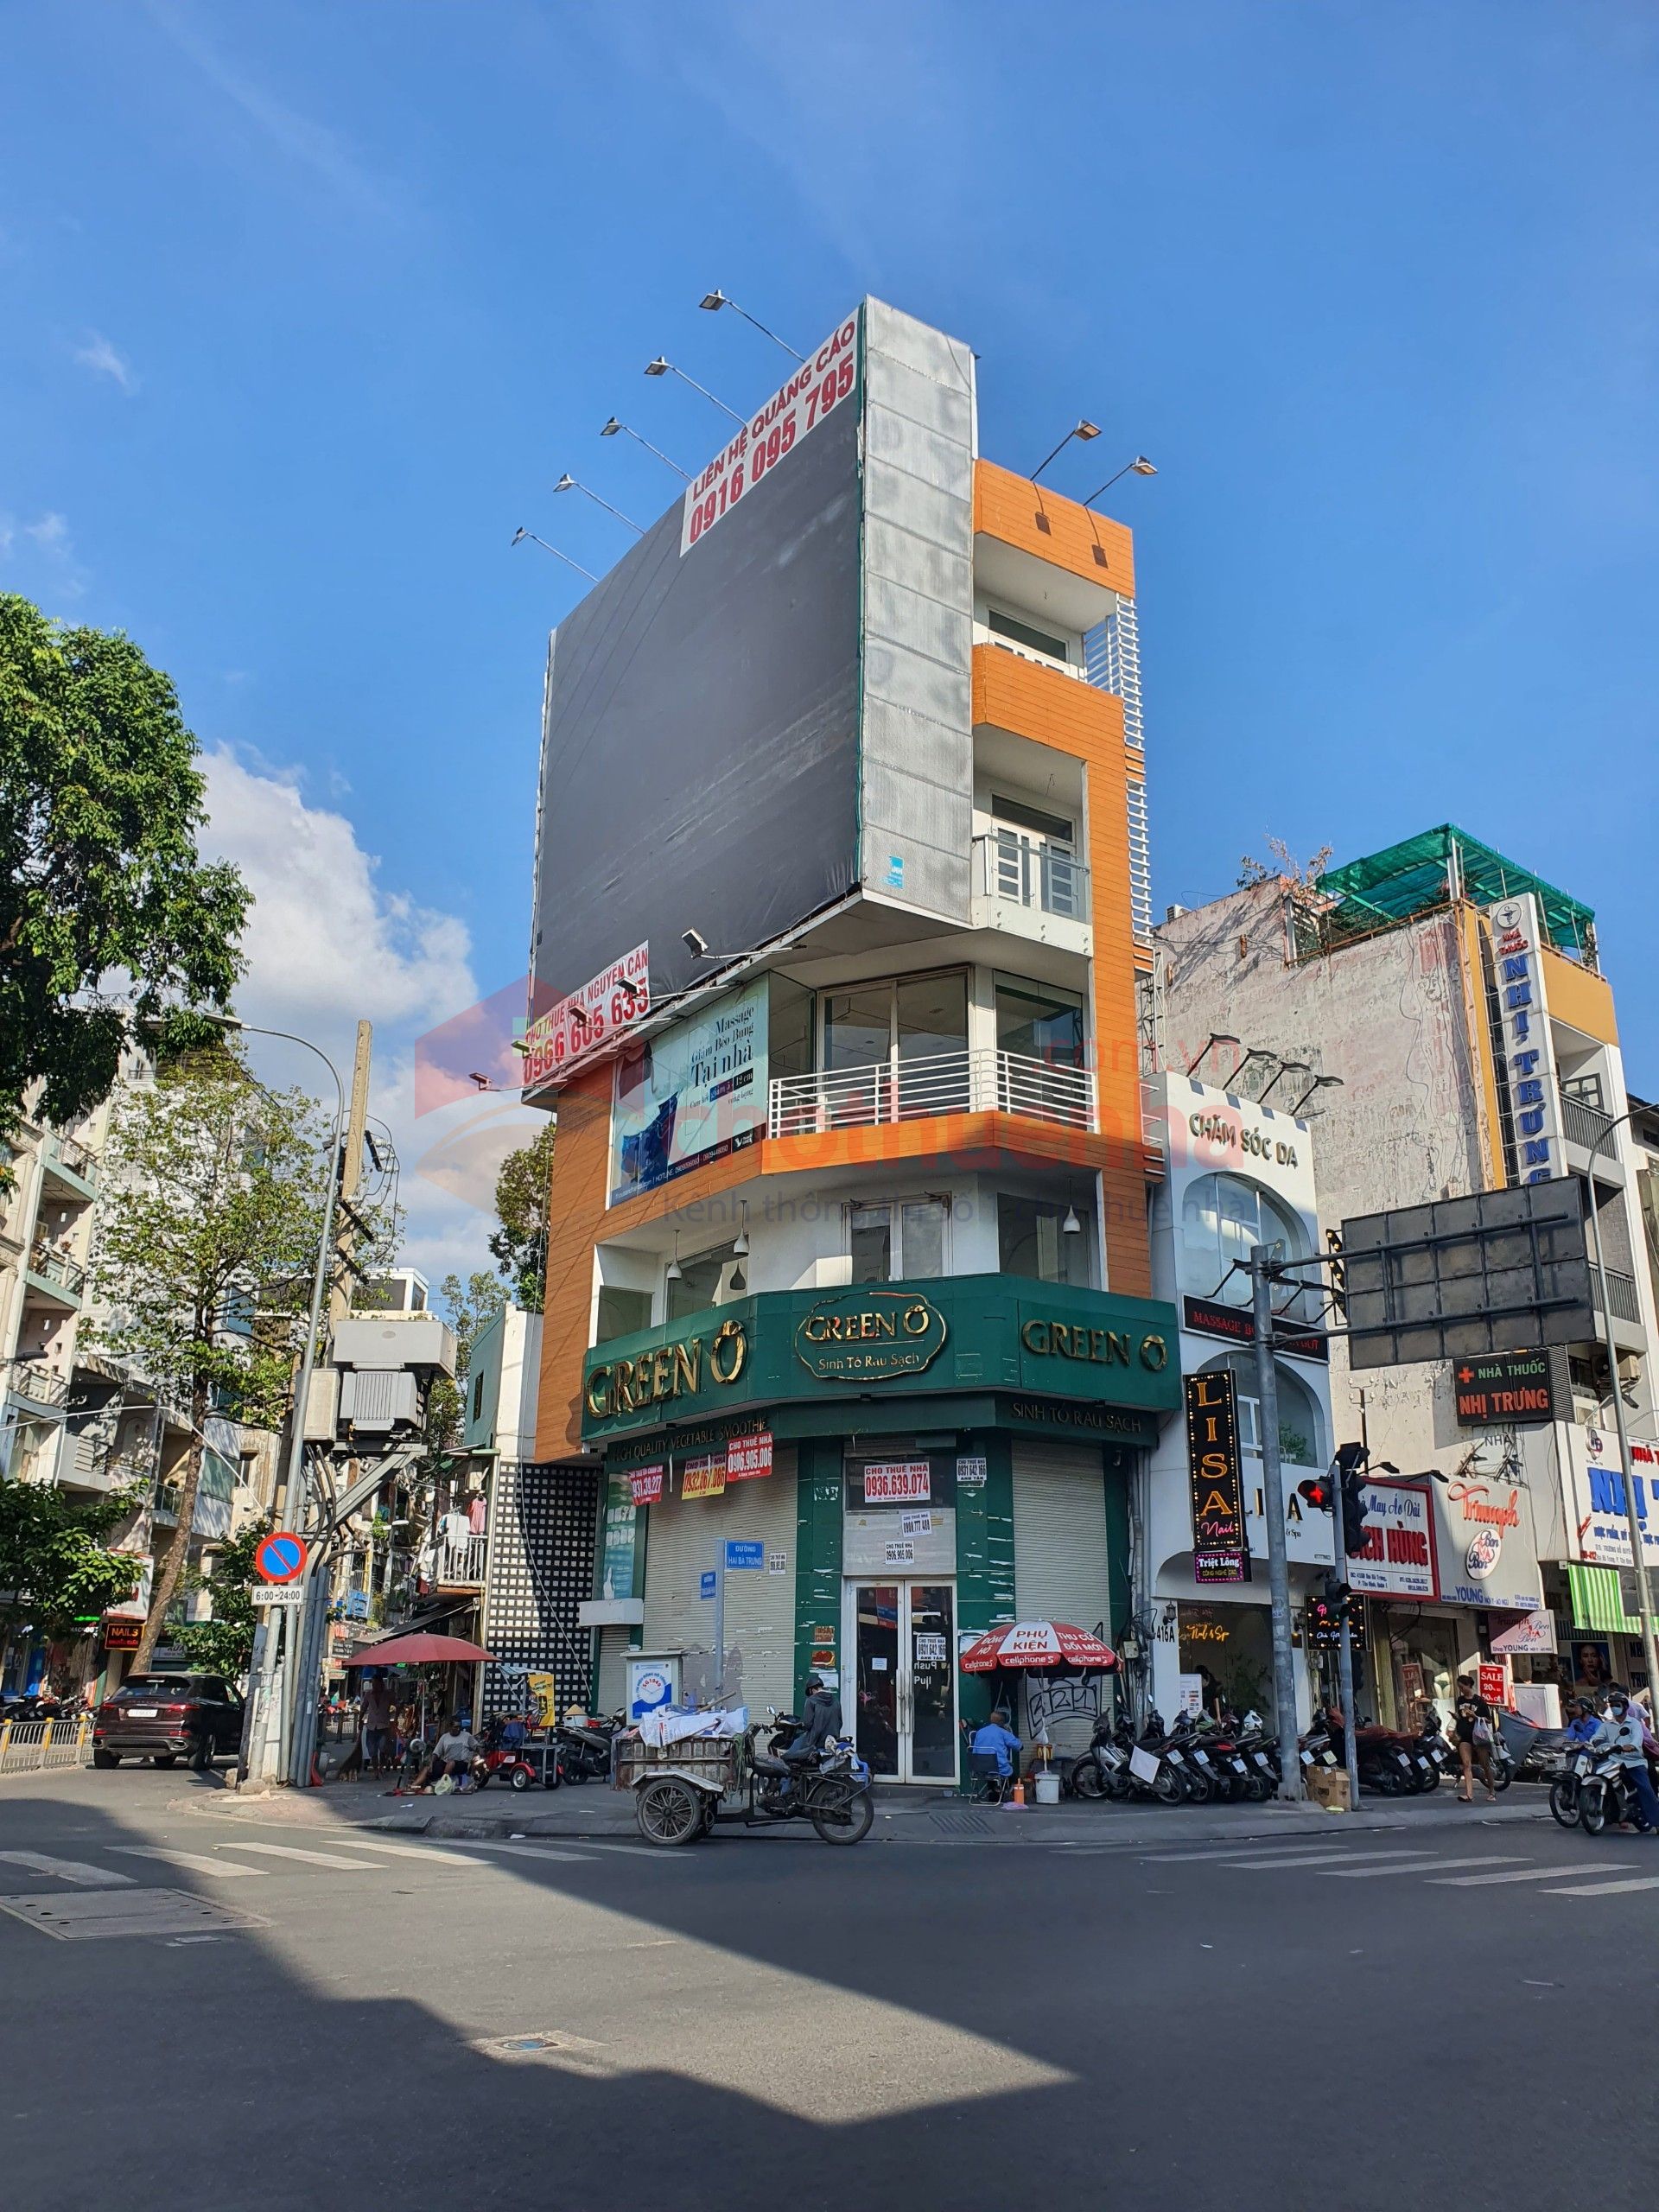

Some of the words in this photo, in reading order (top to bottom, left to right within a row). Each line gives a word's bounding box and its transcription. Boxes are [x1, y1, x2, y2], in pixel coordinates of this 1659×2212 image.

[692, 455, 726, 502] LIÊN
[728, 427, 748, 465] HỆ
[752, 364, 812, 439] QUẢNG
[816, 321, 855, 372] CÁO
[690, 463, 745, 544] 0916
[751, 409, 797, 483] 095
[804, 351, 854, 431] 795
[715, 1007, 754, 1034] Massage
[1189, 1113, 1236, 1147] CHĂM
[1241, 1127, 1272, 1160] SÓC
[1276, 1141, 1299, 1168] DA
[805, 1312, 896, 1341] GREEN
[1193, 1311, 1241, 1332] MASSAGE
[1022, 1319, 1131, 1367] GREEN
[819, 1357, 843, 1370] Sinh
[865, 1355, 887, 1367] Rau
[891, 1351, 919, 1368] Sạch
[1478, 1363, 1503, 1379] NHÀ
[1506, 1357, 1546, 1376] THUỐC
[587, 1338, 702, 1418] GREEN
[1013, 1402, 1046, 1420] SINH
[1074, 1410, 1102, 1427] RAU
[1459, 1394, 1488, 1419] NHỊ
[1491, 1388, 1549, 1412] TRƯNG
[634, 1439, 668, 1461] QUALITY
[671, 1430, 715, 1450] VEGETABLE
[719, 1417, 767, 1441] SMOOTHIE
[729, 1442, 741, 1451] CHO
[743, 1438, 758, 1448] THUÊ
[760, 1433, 773, 1444] NHÀ
[1197, 1382, 1234, 1516] LISA
[886, 1465, 907, 1474] THUÊ
[910, 1463, 928, 1472] NHÀ
[866, 1472, 929, 1497] 0936.639.074
[1447, 1481, 1520, 1539] Triumph
[1201, 1522, 1235, 1537] Nail
[1291, 1529, 1301, 1539] Spa
[1387, 1520, 1428, 1567] HÙNG
[1198, 1557, 1218, 1568] Triệt
[1219, 1556, 1240, 1568] Lông
[1455, 1586, 1484, 1604] YOUNG
[1016, 1630, 1048, 1638] PHỤ
[1058, 1631, 1077, 1641] THU
[1157, 1625, 1175, 1643] 416A
[1013, 1640, 1047, 1651] KIỆN
[914, 1675, 931, 1685] Pull
[1481, 1671, 1503, 1682] SALE
